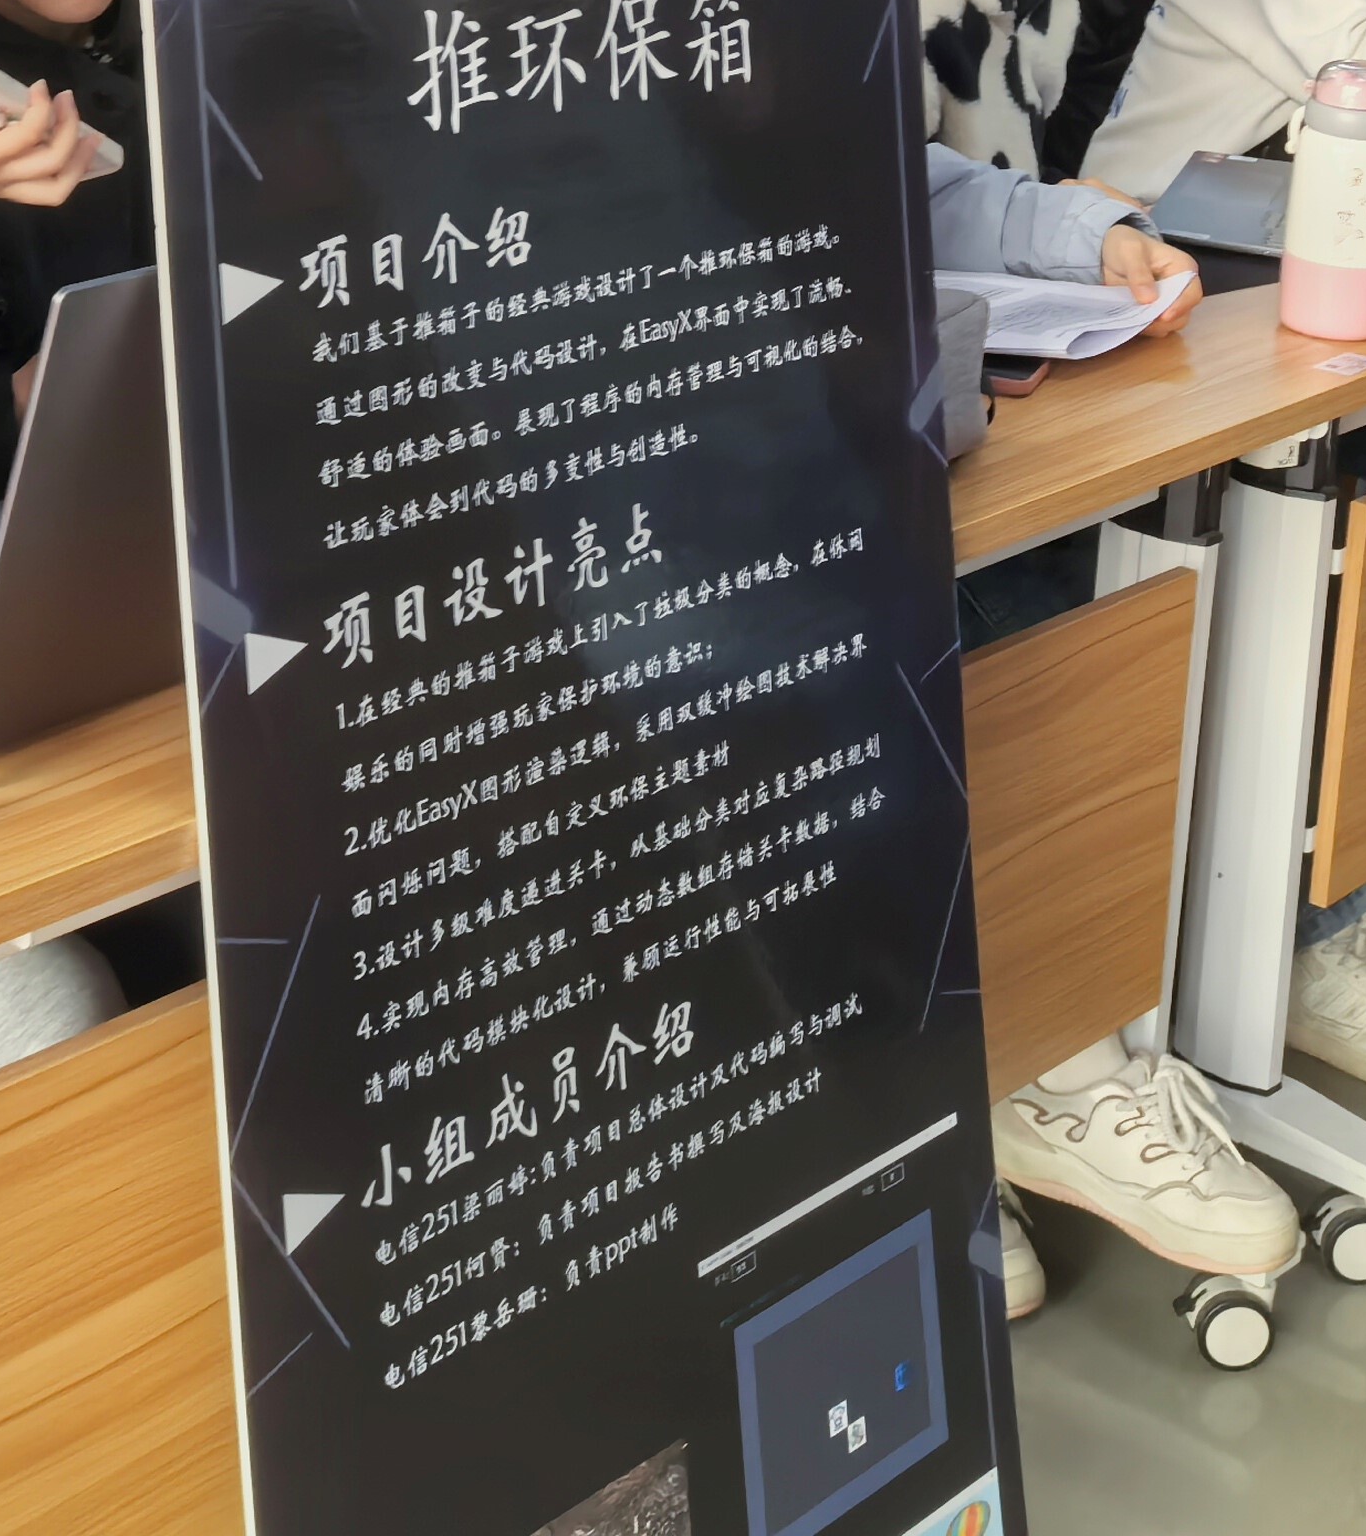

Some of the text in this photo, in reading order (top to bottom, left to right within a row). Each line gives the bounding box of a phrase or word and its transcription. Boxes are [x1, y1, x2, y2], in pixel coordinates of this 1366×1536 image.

[297, 207, 532, 310] 项目介绍
[325, 503, 664, 670] 项目设计亮点
[360, 1000, 696, 1208] 小组成员介绍
